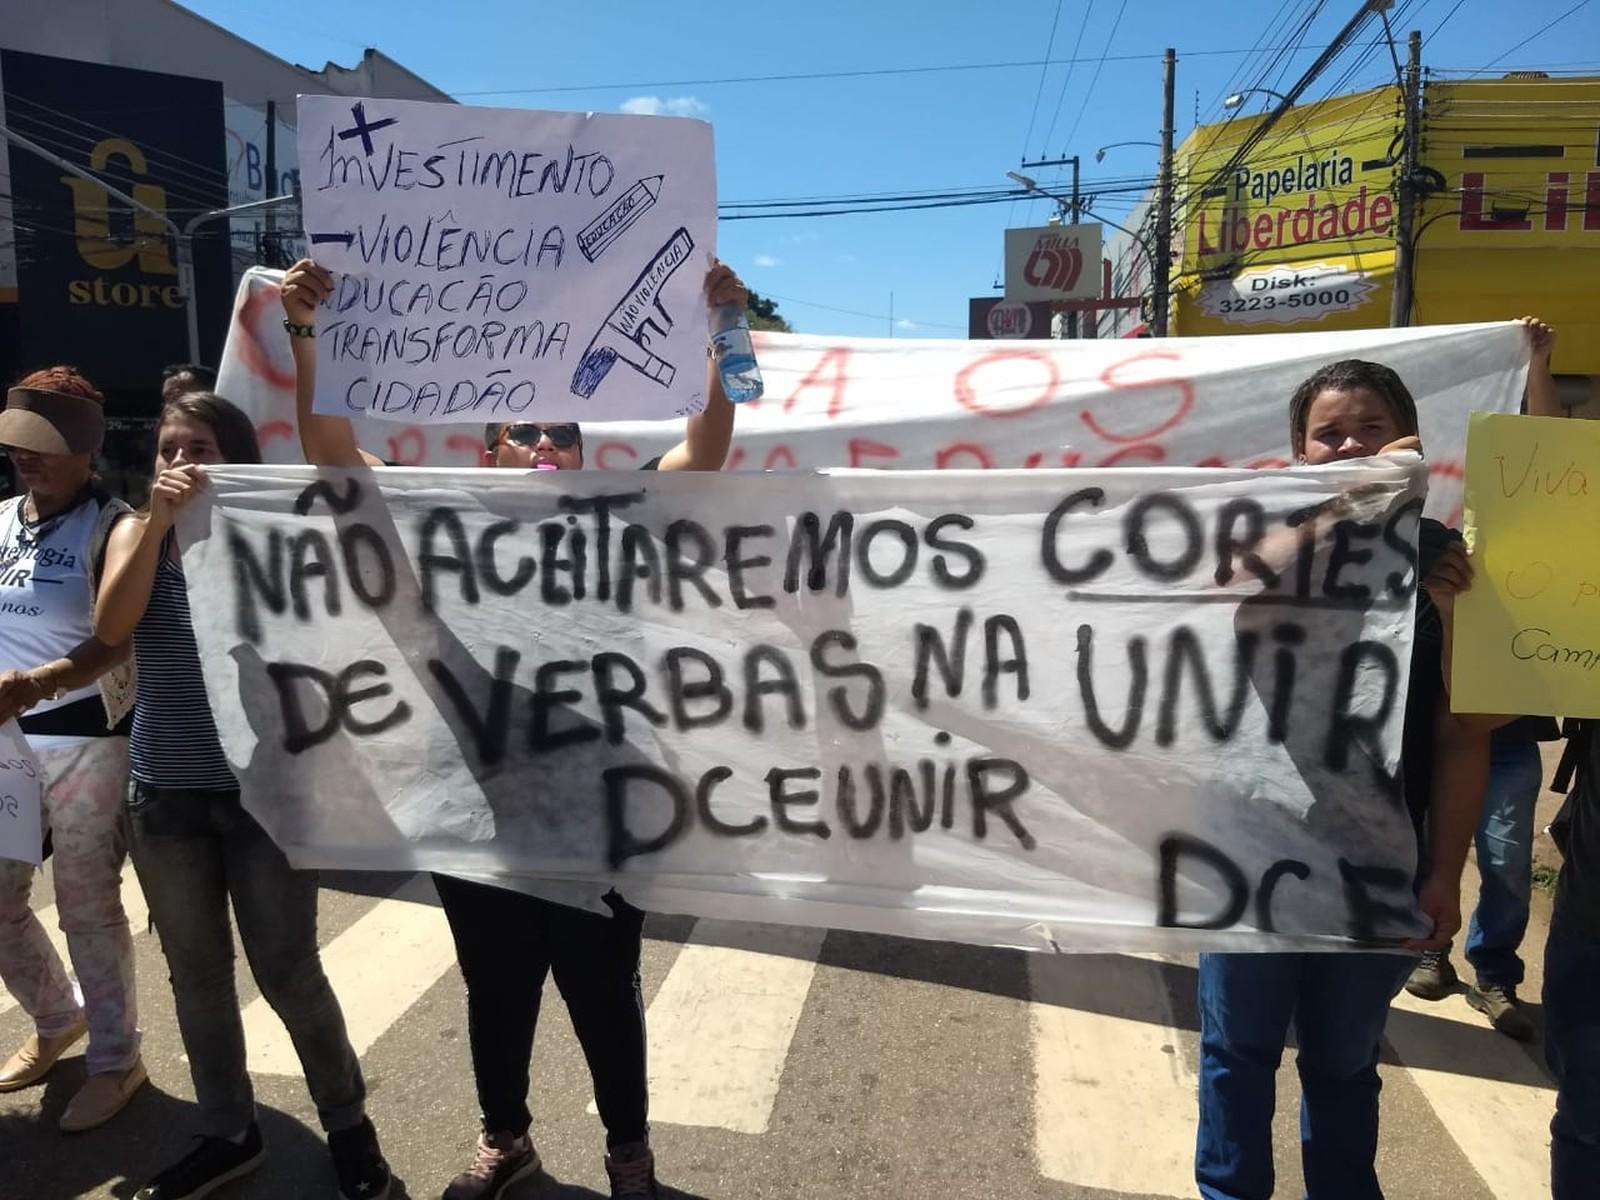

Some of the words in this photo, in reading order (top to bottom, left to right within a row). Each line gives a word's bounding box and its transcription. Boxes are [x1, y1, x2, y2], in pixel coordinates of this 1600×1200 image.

[1235, 150, 1353, 206] Papelaria
[1199, 186, 1393, 256] Liberdade
[68, 277, 186, 308] store
[1220, 289, 1350, 314] 3223-5000
[1252, 275, 1317, 292] Disk:
[323, 320, 570, 367] TRANSFORMA
[346, 369, 536, 416] CIDADÃO
[1495, 441, 1588, 498] Viva
[226, 478, 397, 645] NÃO
[1041, 486, 1423, 600] CORTES
[267, 660, 413, 756] DE
[429, 630, 887, 765] VERBAS
[912, 607, 1030, 711] NA
[1157, 831, 1412, 939] DCE
